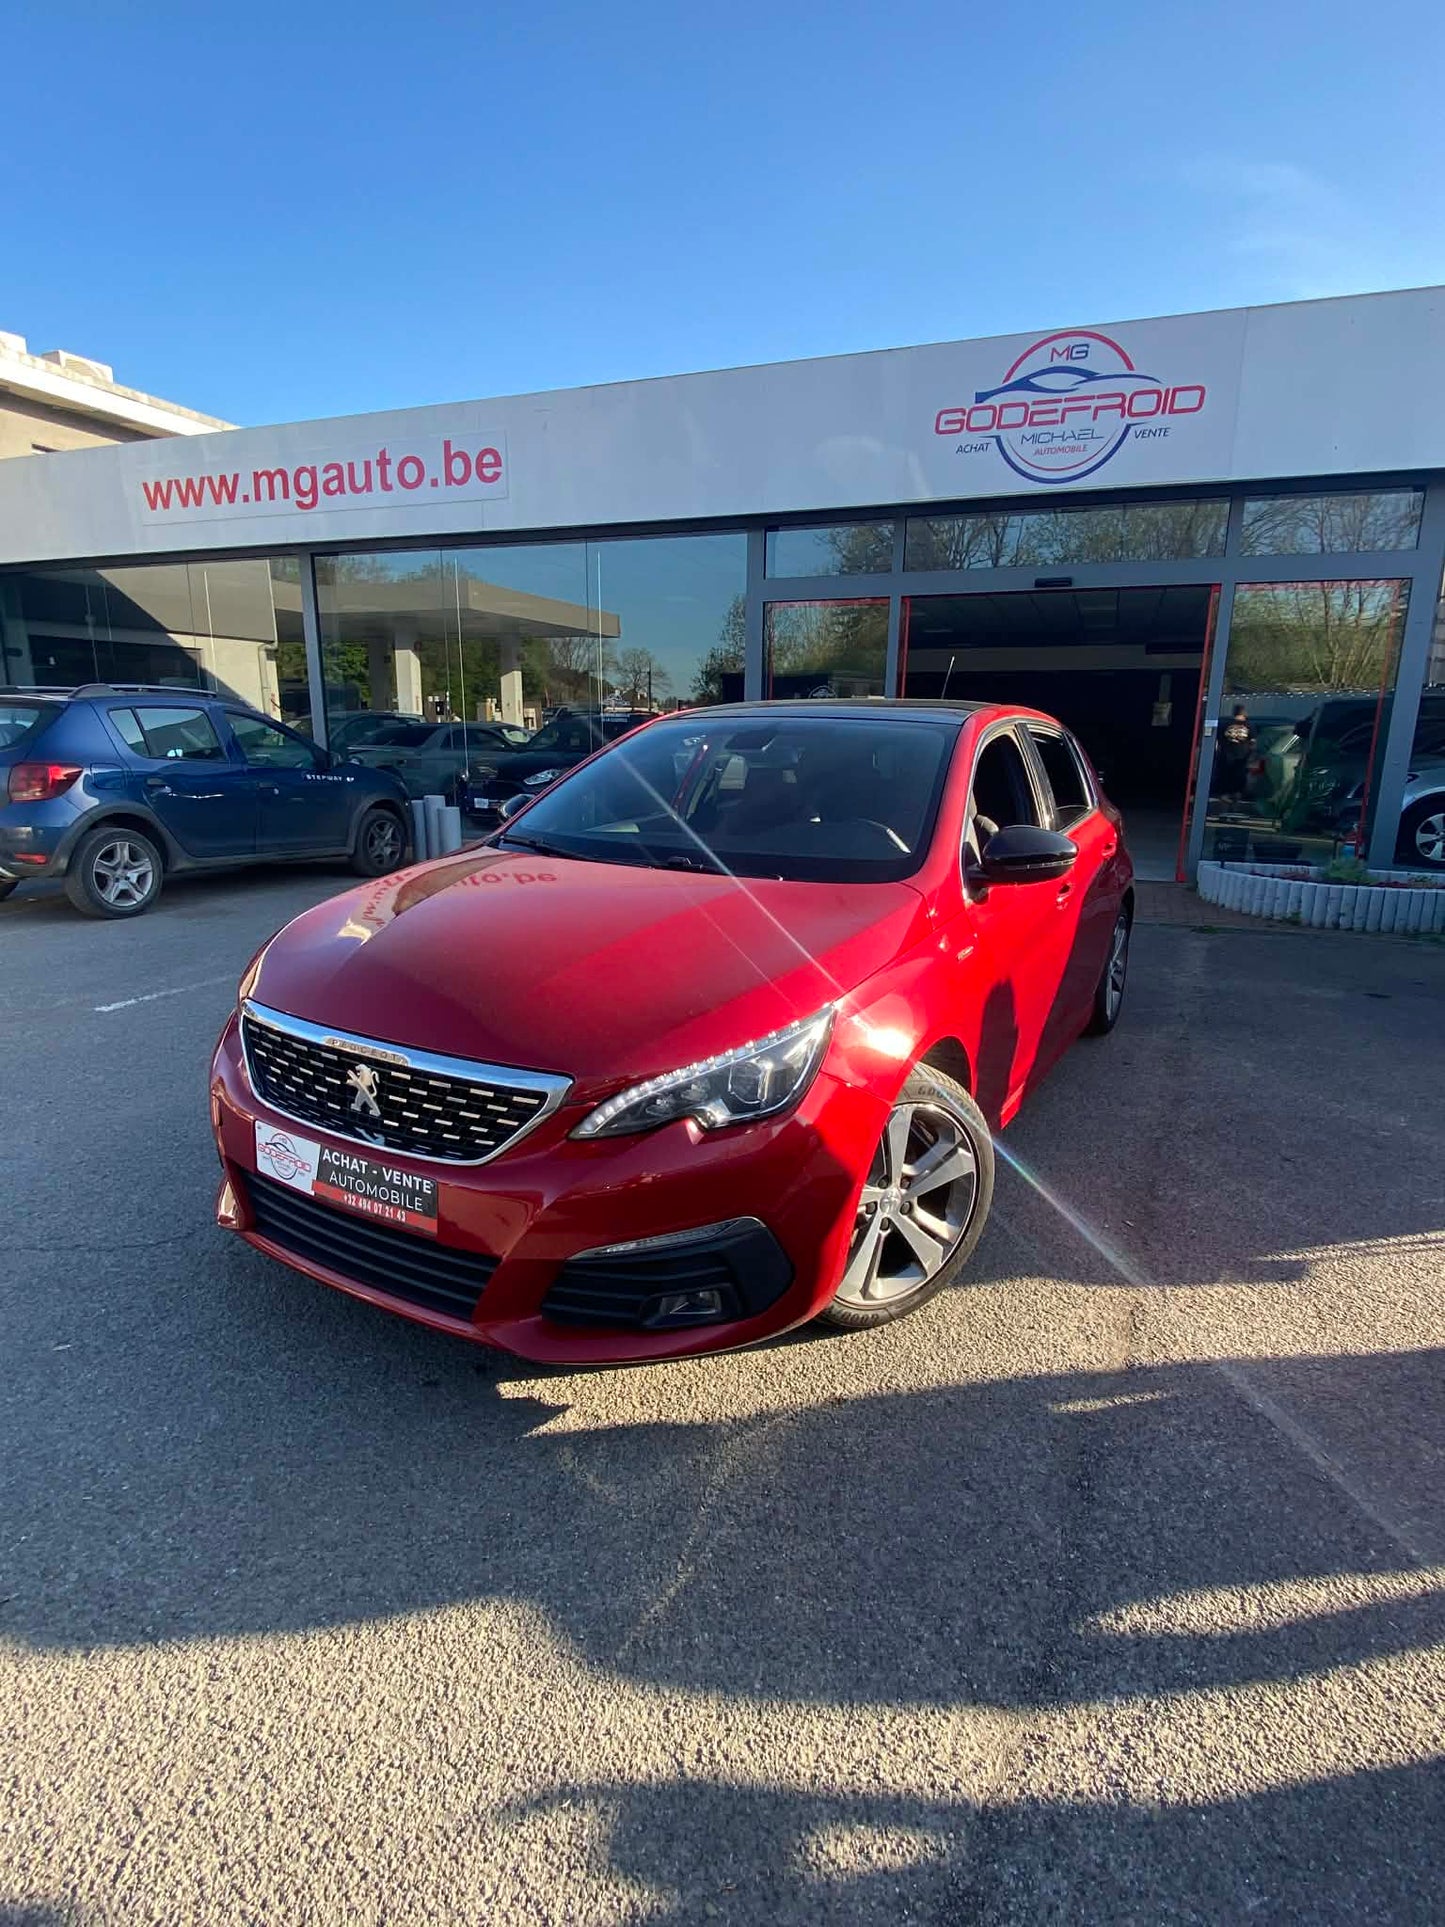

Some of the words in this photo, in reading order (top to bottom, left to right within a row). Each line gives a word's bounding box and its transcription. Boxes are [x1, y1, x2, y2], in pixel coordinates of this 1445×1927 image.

[1050, 343, 1090, 362] MG
[934, 384, 1206, 435] GODEFROID
[1020, 428, 1104, 445] MICHAEL
[1134, 427, 1172, 439] VENTE
[955, 442, 991, 454] ACHAT
[1033, 444, 1088, 456] AUTOMOBILE
[142, 440, 503, 511] www.mgauto.be
[306, 774, 342, 782] STEPWAY
[322, 1149, 368, 1174] ACHAT
[382, 1167, 432, 1194] VENTE
[329, 1171, 423, 1212] AUTOMOBILE
[385, 1206, 394, 1218] 21
